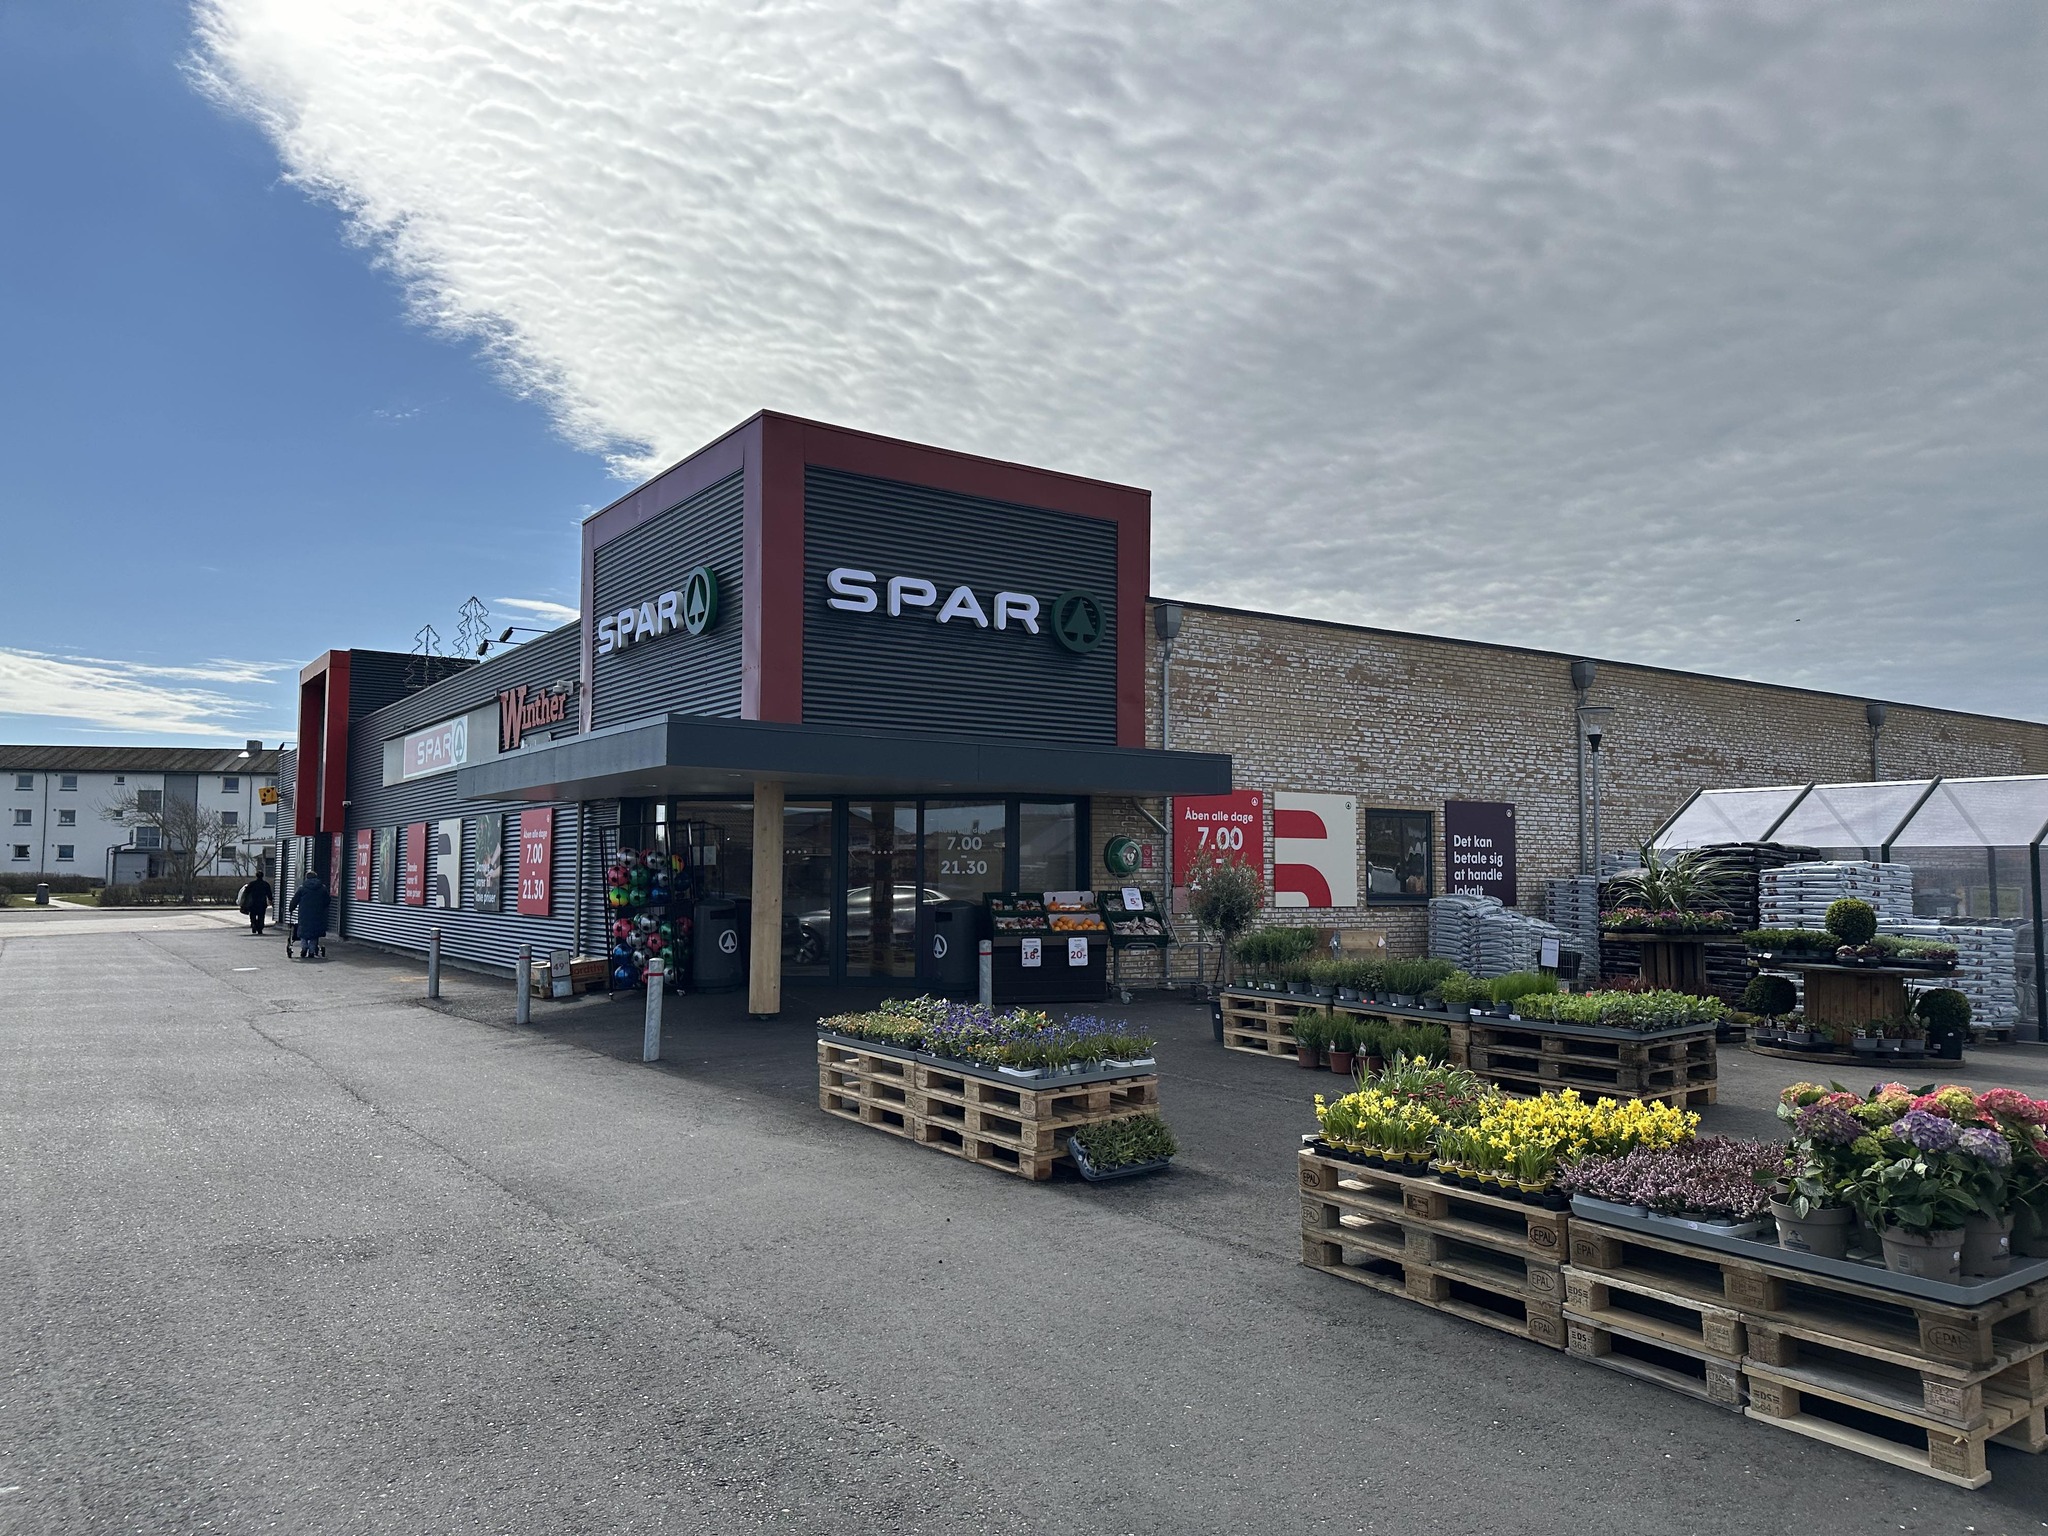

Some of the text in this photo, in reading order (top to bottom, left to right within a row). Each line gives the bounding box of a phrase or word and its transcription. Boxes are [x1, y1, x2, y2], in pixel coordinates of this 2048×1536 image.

[827, 567, 1040, 635] SPAR
[597, 590, 684, 655] SPAR
[501, 684, 567, 750] Winther
[417, 732, 451, 766] SPAR
[1185, 806, 1254, 824] Åben alle dage
[947, 836, 983, 851] 7.00
[1197, 826, 1243, 850] 7.00
[1453, 834, 1493, 848] Det kan
[526, 843, 543, 864] 7.00
[1453, 851, 1503, 867] betale sig
[941, 860, 988, 875] 21.30
[1454, 868, 1503, 881] at handle
[522, 879, 544, 900] 21.30
[1454, 885, 1484, 896] lokalt
[1302, 1172, 1317, 1184] EPAL
[1533, 1229, 1554, 1244] EPAL
[1532, 1274, 1551, 1288] EPAL
